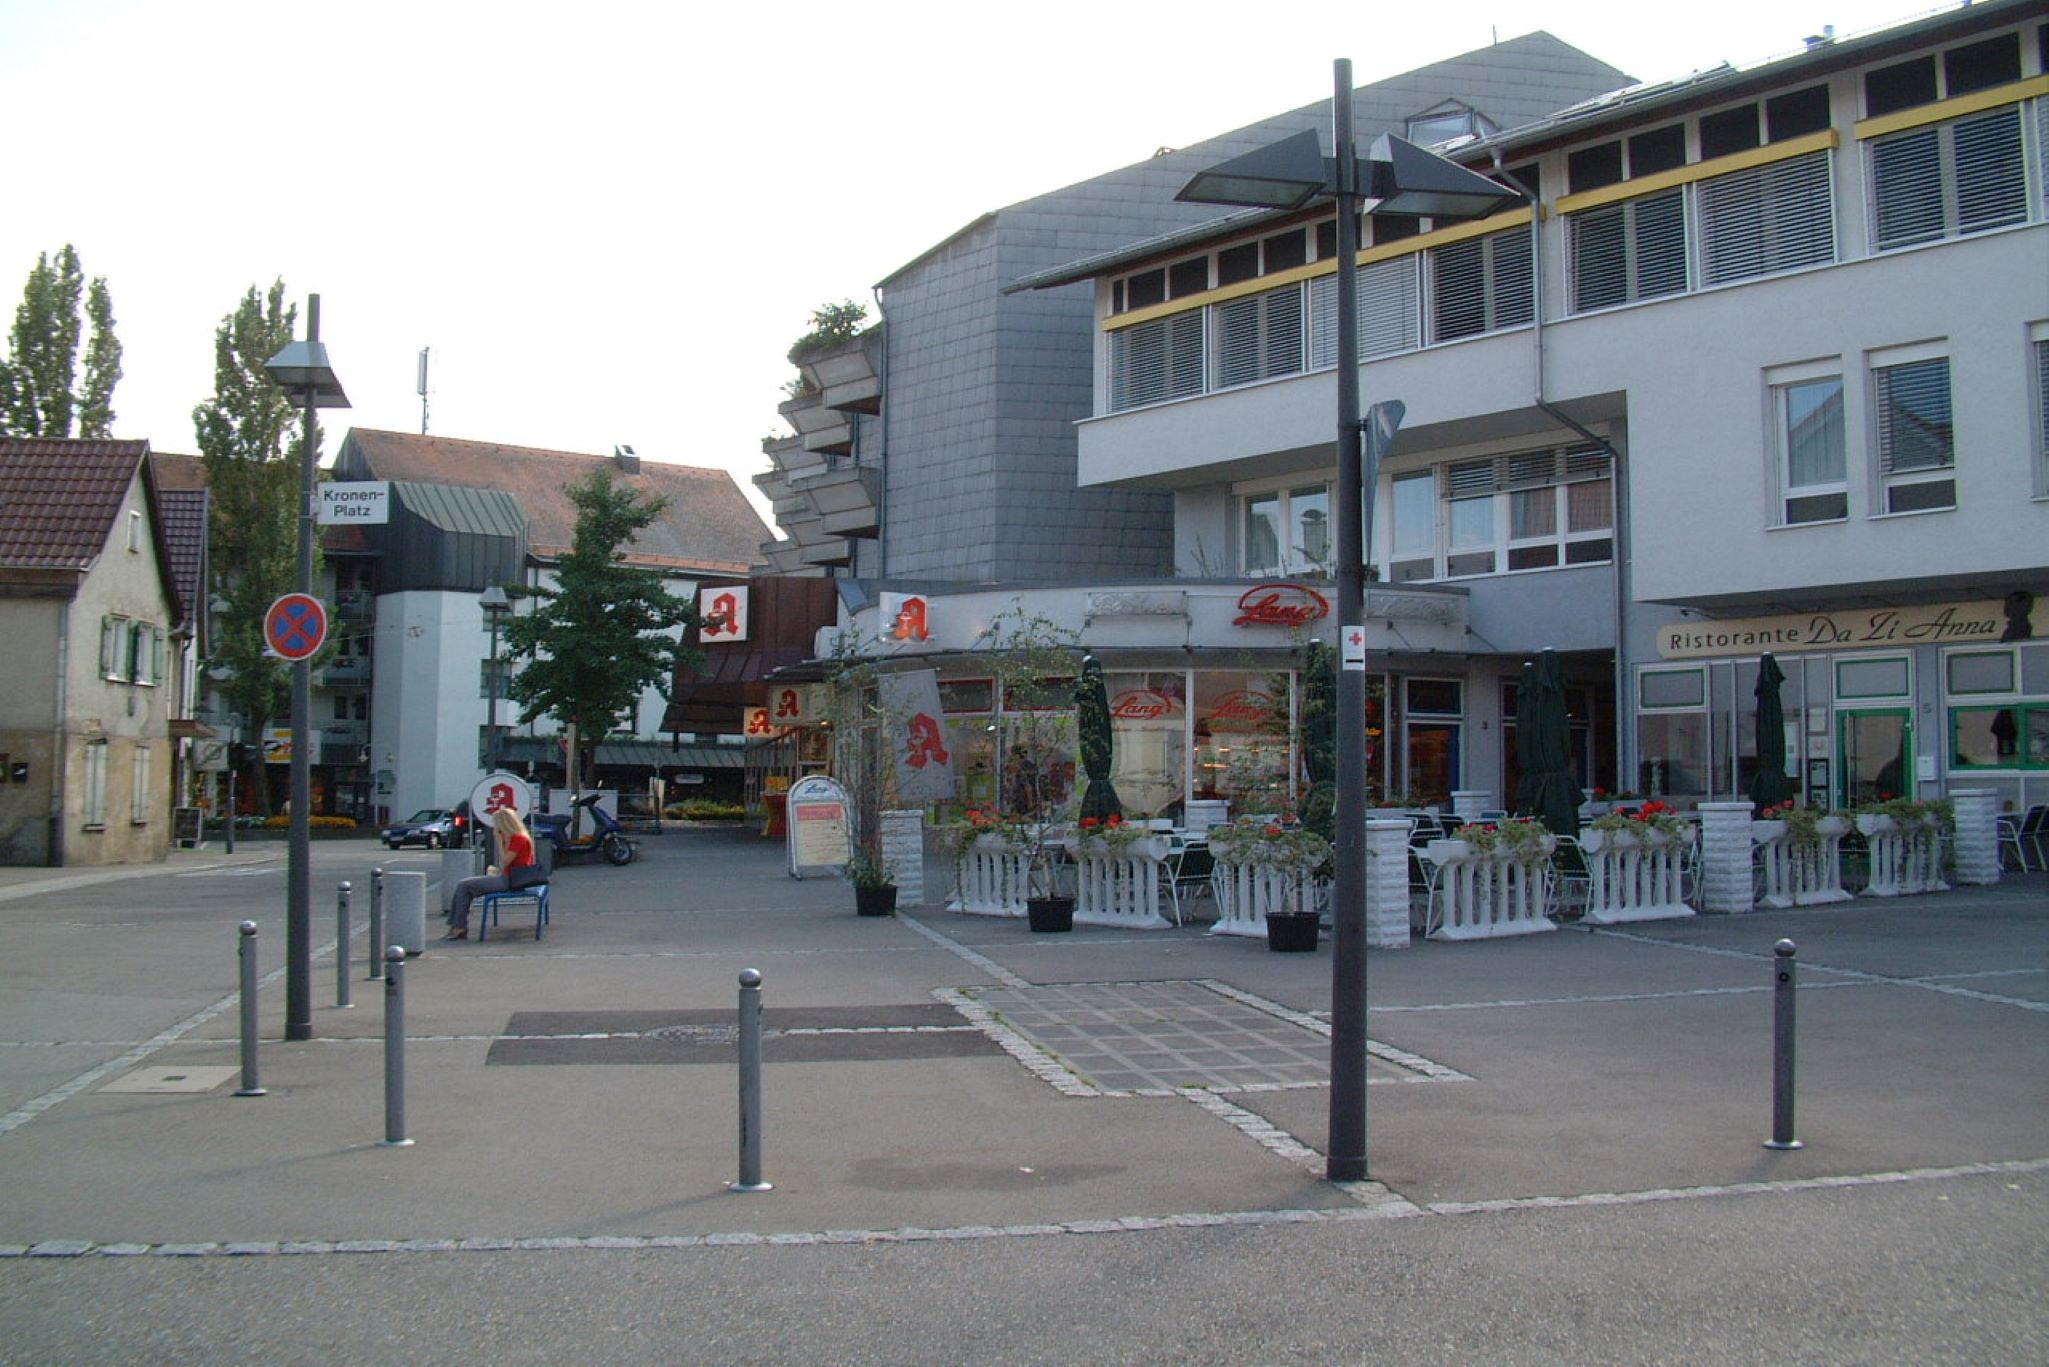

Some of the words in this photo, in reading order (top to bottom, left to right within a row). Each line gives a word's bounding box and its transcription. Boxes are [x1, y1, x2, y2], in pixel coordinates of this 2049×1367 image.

[324, 490, 385, 502] Kronen-
[334, 504, 371, 517] Platz
[1670, 628, 1800, 650] Ristorante
[1803, 615, 1852, 644] Da
[1904, 607, 1997, 639] Anna
[1110, 695, 1166, 718] Lang
